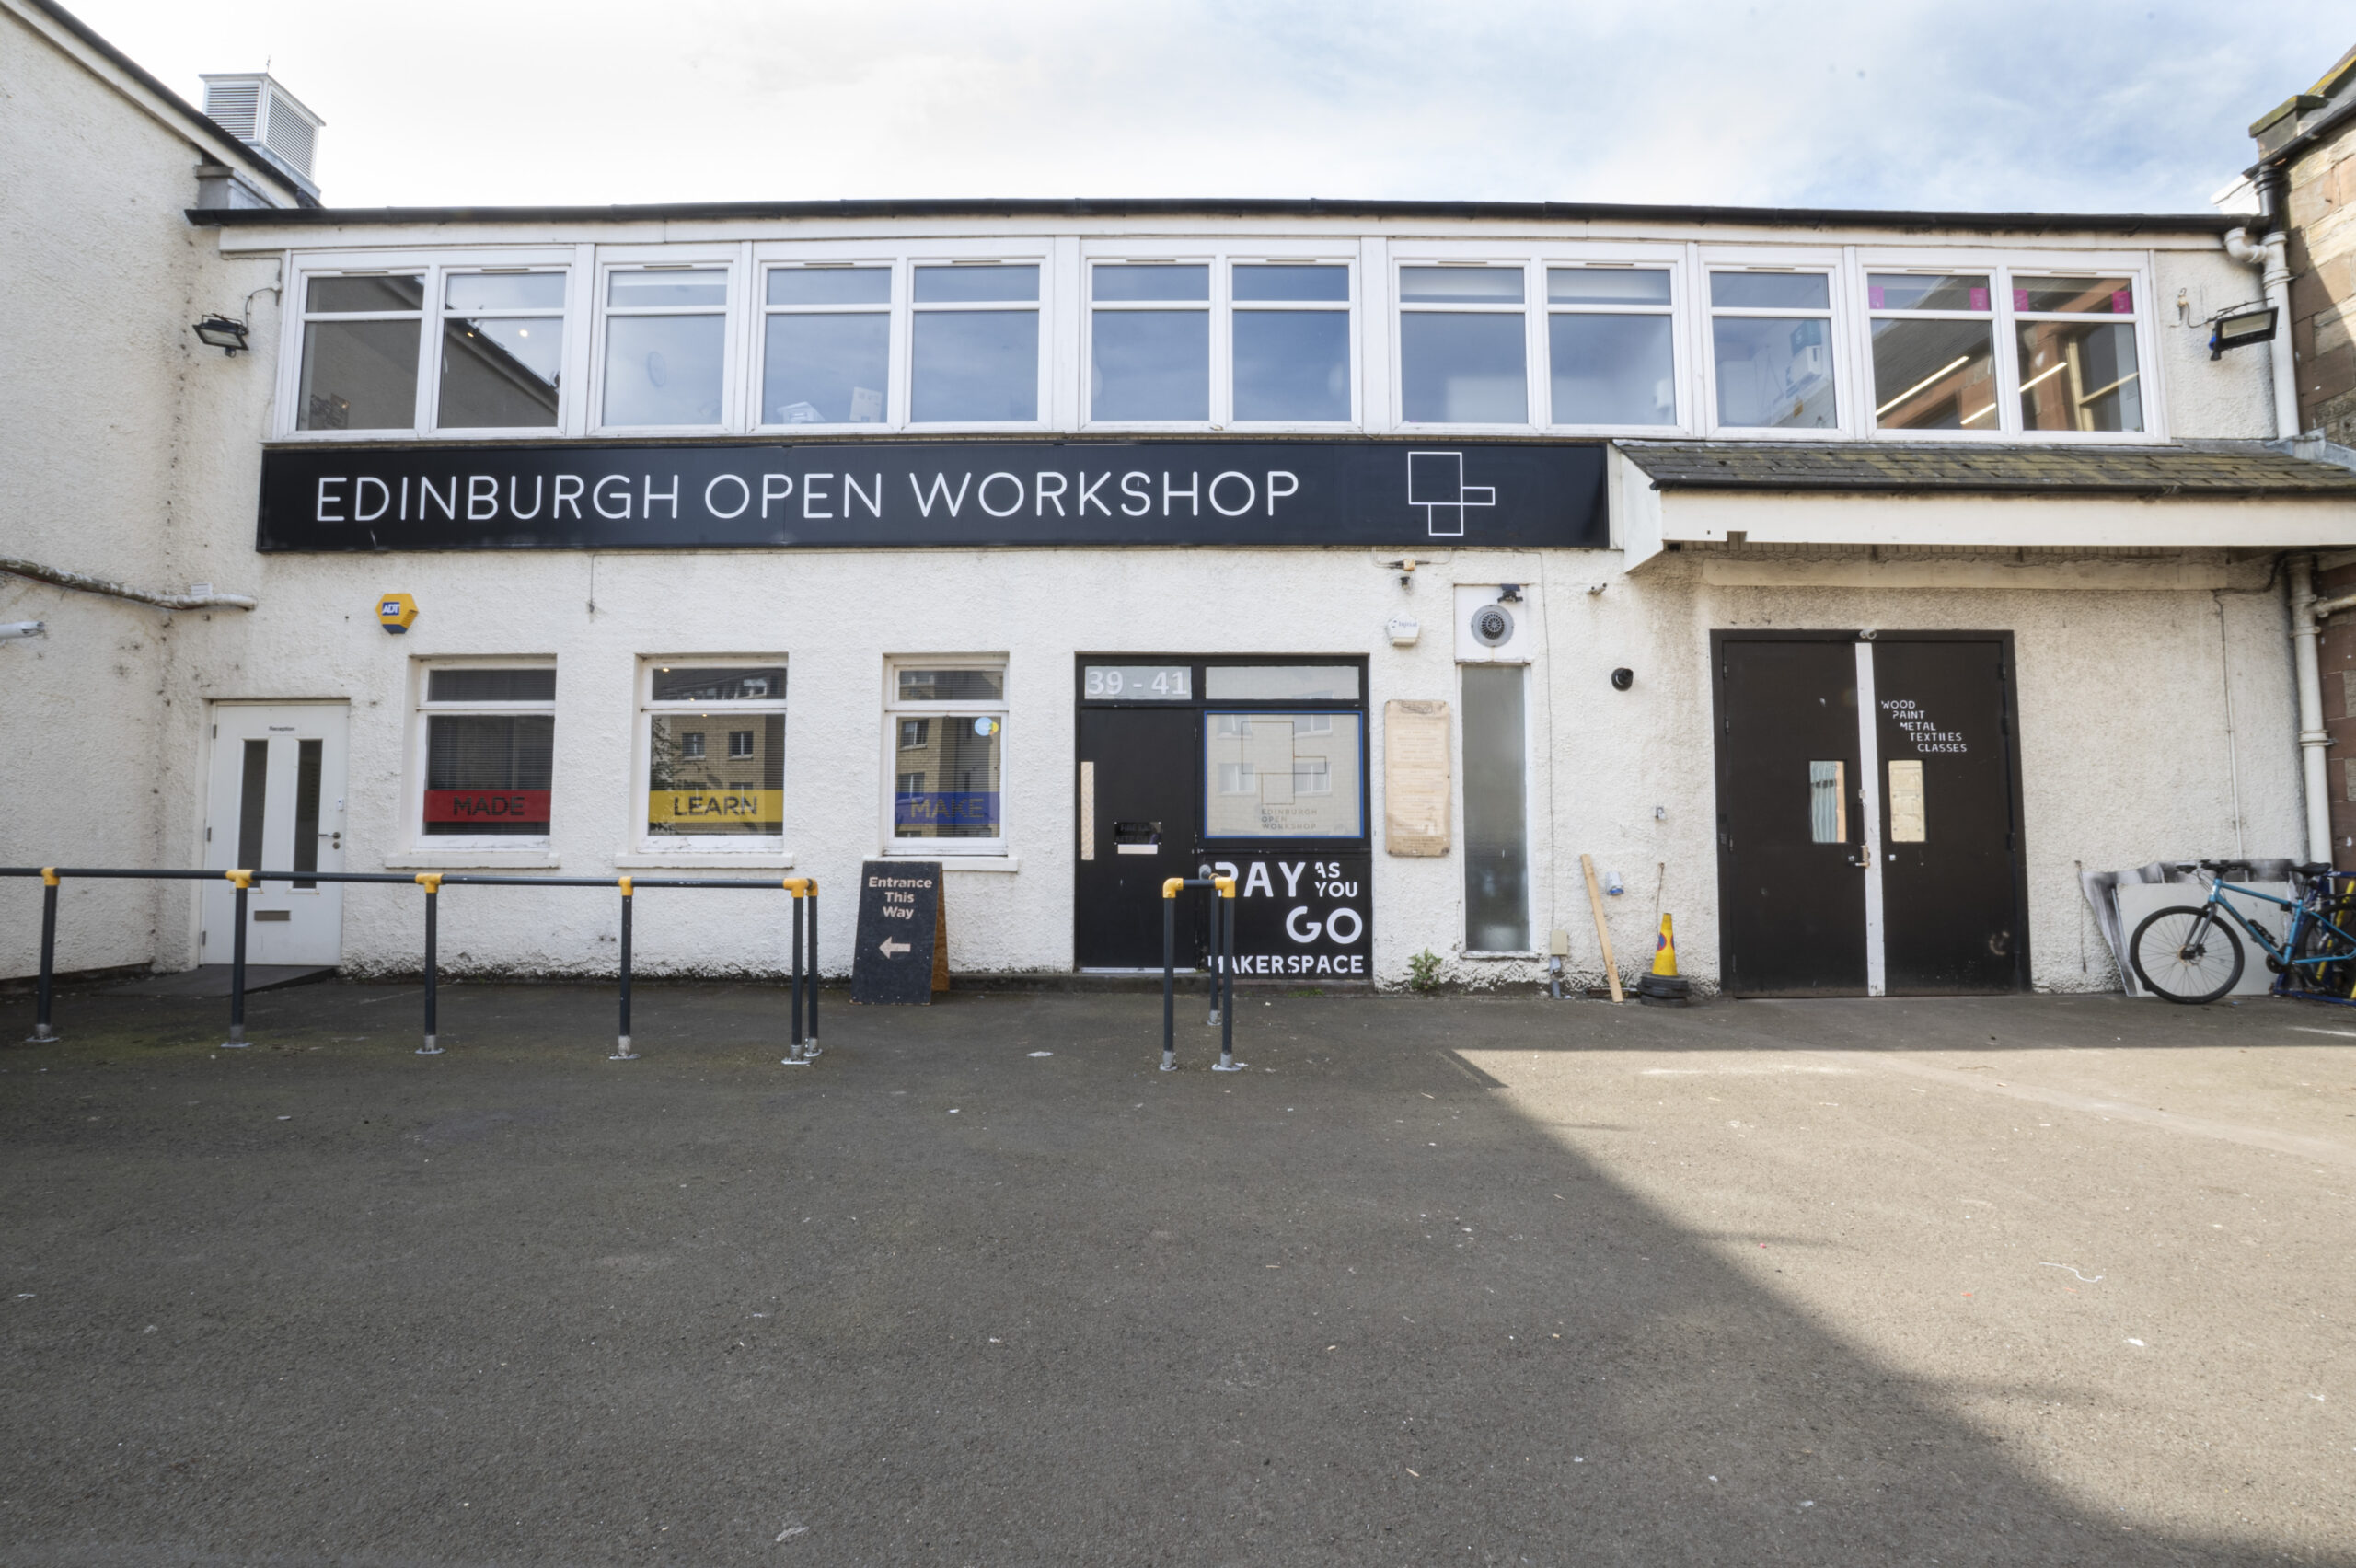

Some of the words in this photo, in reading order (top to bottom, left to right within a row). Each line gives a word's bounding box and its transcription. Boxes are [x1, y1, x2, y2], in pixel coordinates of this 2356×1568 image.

[316, 473, 678, 522] EDINBURGH
[705, 472, 882, 520] OPEN
[909, 471, 1299, 519] WORKSHOP
[383, 603, 399, 614] ADT
[1088, 671, 1124, 695] 39
[1151, 671, 1187, 695] 41
[1880, 699, 1915, 709] WOOD
[1892, 710, 1924, 719] PAINT
[1900, 721, 1936, 731] METAL
[1917, 744, 1968, 753] CLASSES
[453, 796, 525, 816] MADE
[674, 796, 758, 816] LEARN
[911, 798, 984, 818] MAKE
[1314, 861, 1341, 879] AS
[868, 876, 932, 889] Entrance
[1215, 861, 1306, 897] PAY
[884, 891, 915, 903] This
[1314, 881, 1358, 898] YOU
[883, 906, 914, 920] Way
[1286, 905, 1363, 945] GO
